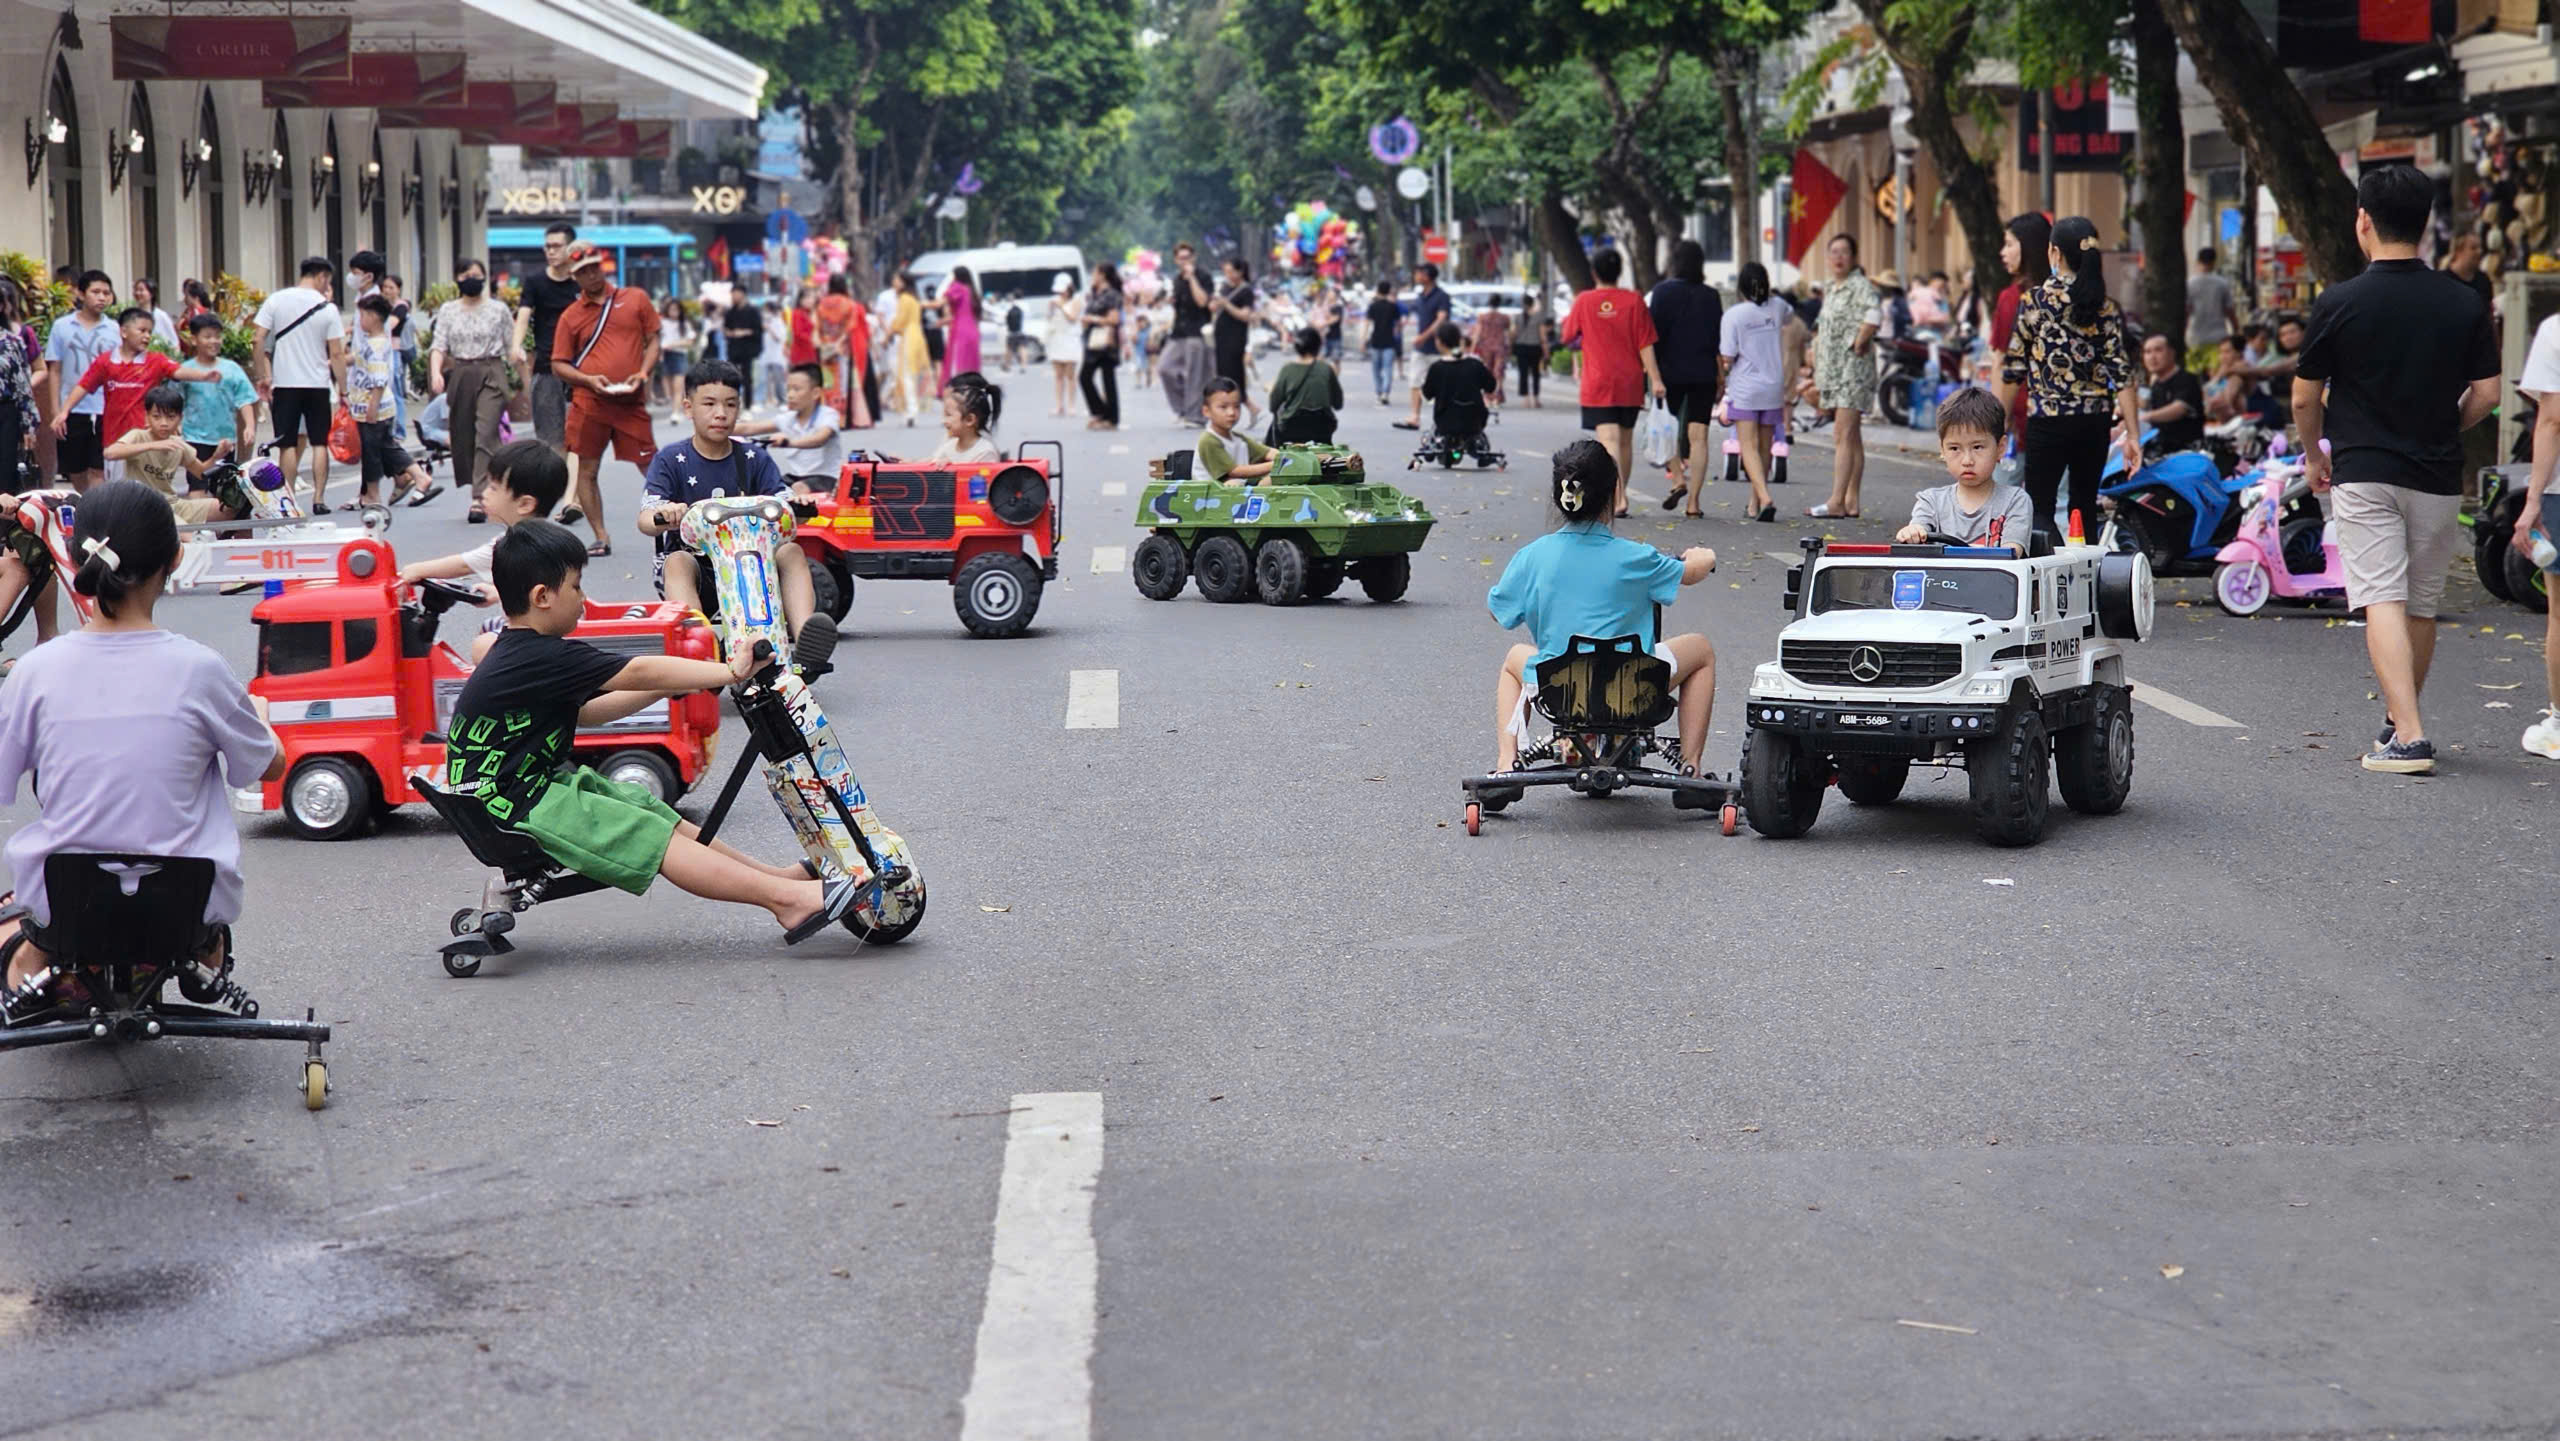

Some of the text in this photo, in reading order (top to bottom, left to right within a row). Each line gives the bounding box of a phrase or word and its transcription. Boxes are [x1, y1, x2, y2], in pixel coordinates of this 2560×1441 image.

[1183, 493, 1191, 503] 2
[262, 549, 294, 570] 911
[2031, 629, 2046, 641] SPORT
[2051, 637, 2080, 659] POWER
[1839, 714, 1857, 725] ABM
